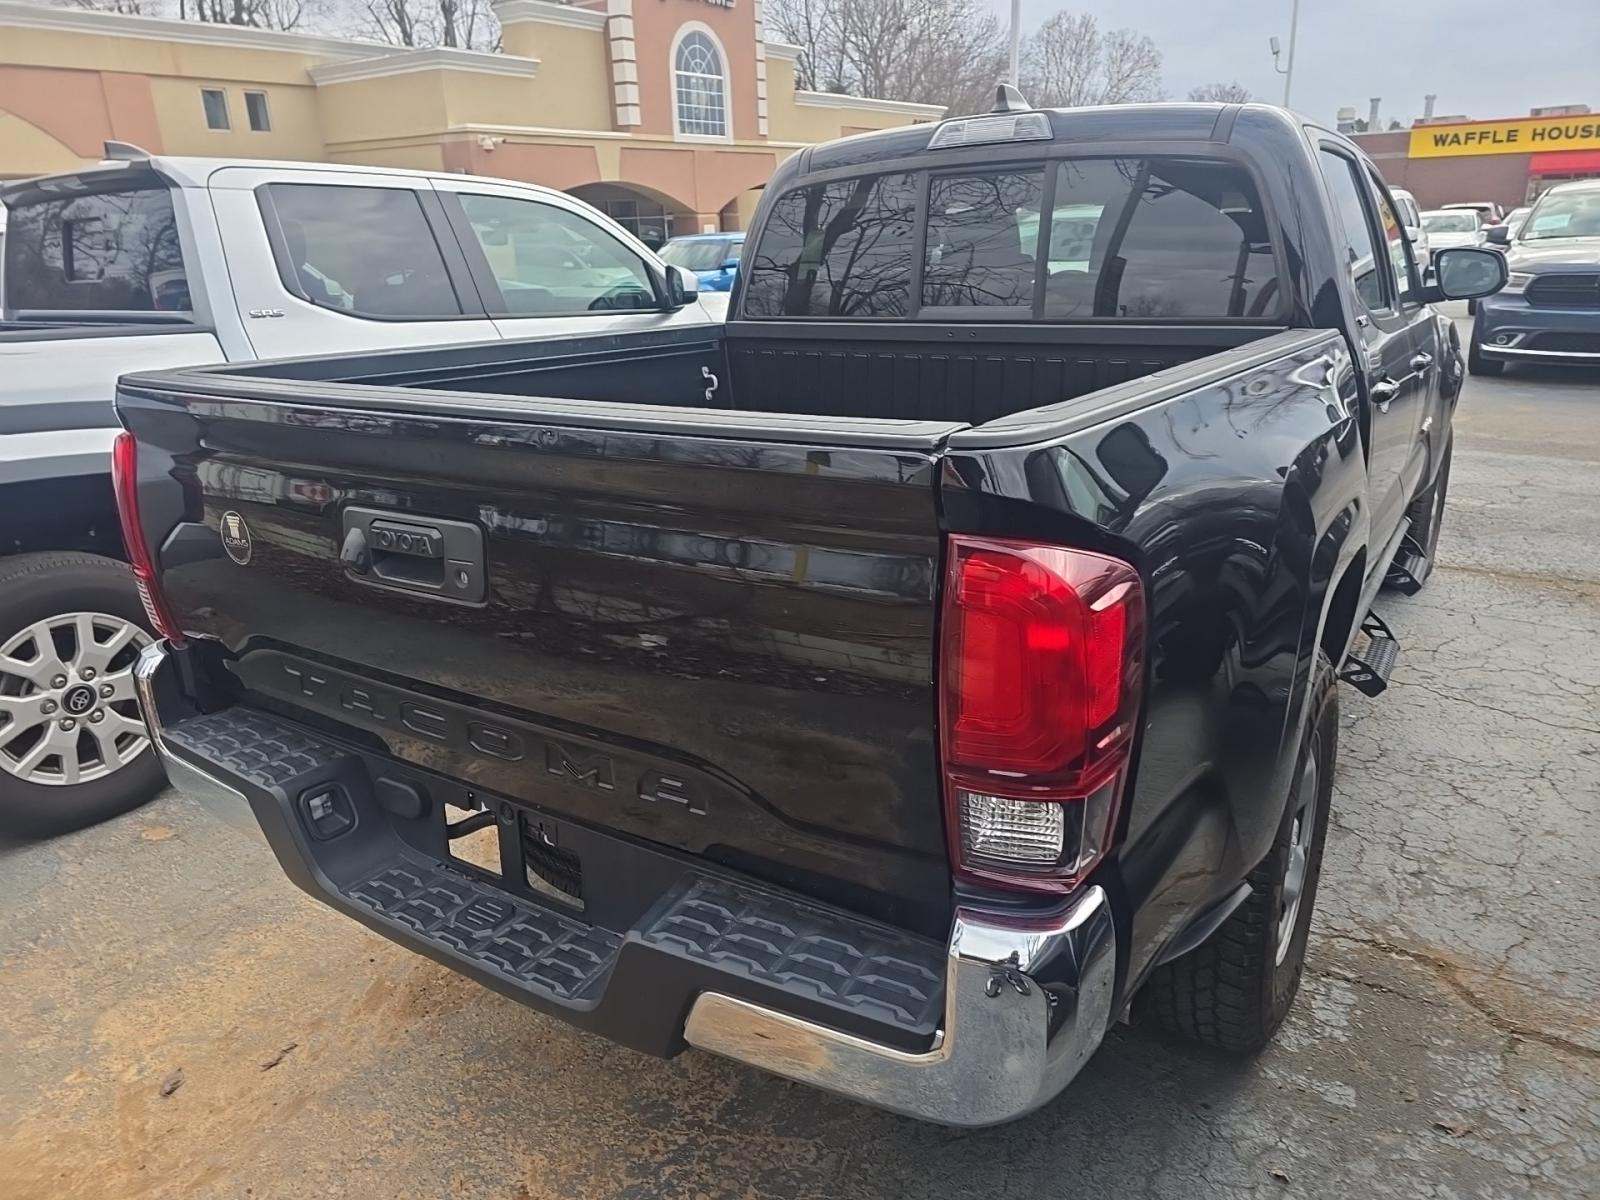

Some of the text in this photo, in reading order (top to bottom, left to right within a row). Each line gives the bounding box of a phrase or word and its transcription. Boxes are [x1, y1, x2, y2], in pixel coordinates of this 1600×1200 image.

[1433, 129, 1519, 147] WAFFLE
[370, 528, 432, 555] TOYOTA
[283, 664, 708, 816] TACOMA
